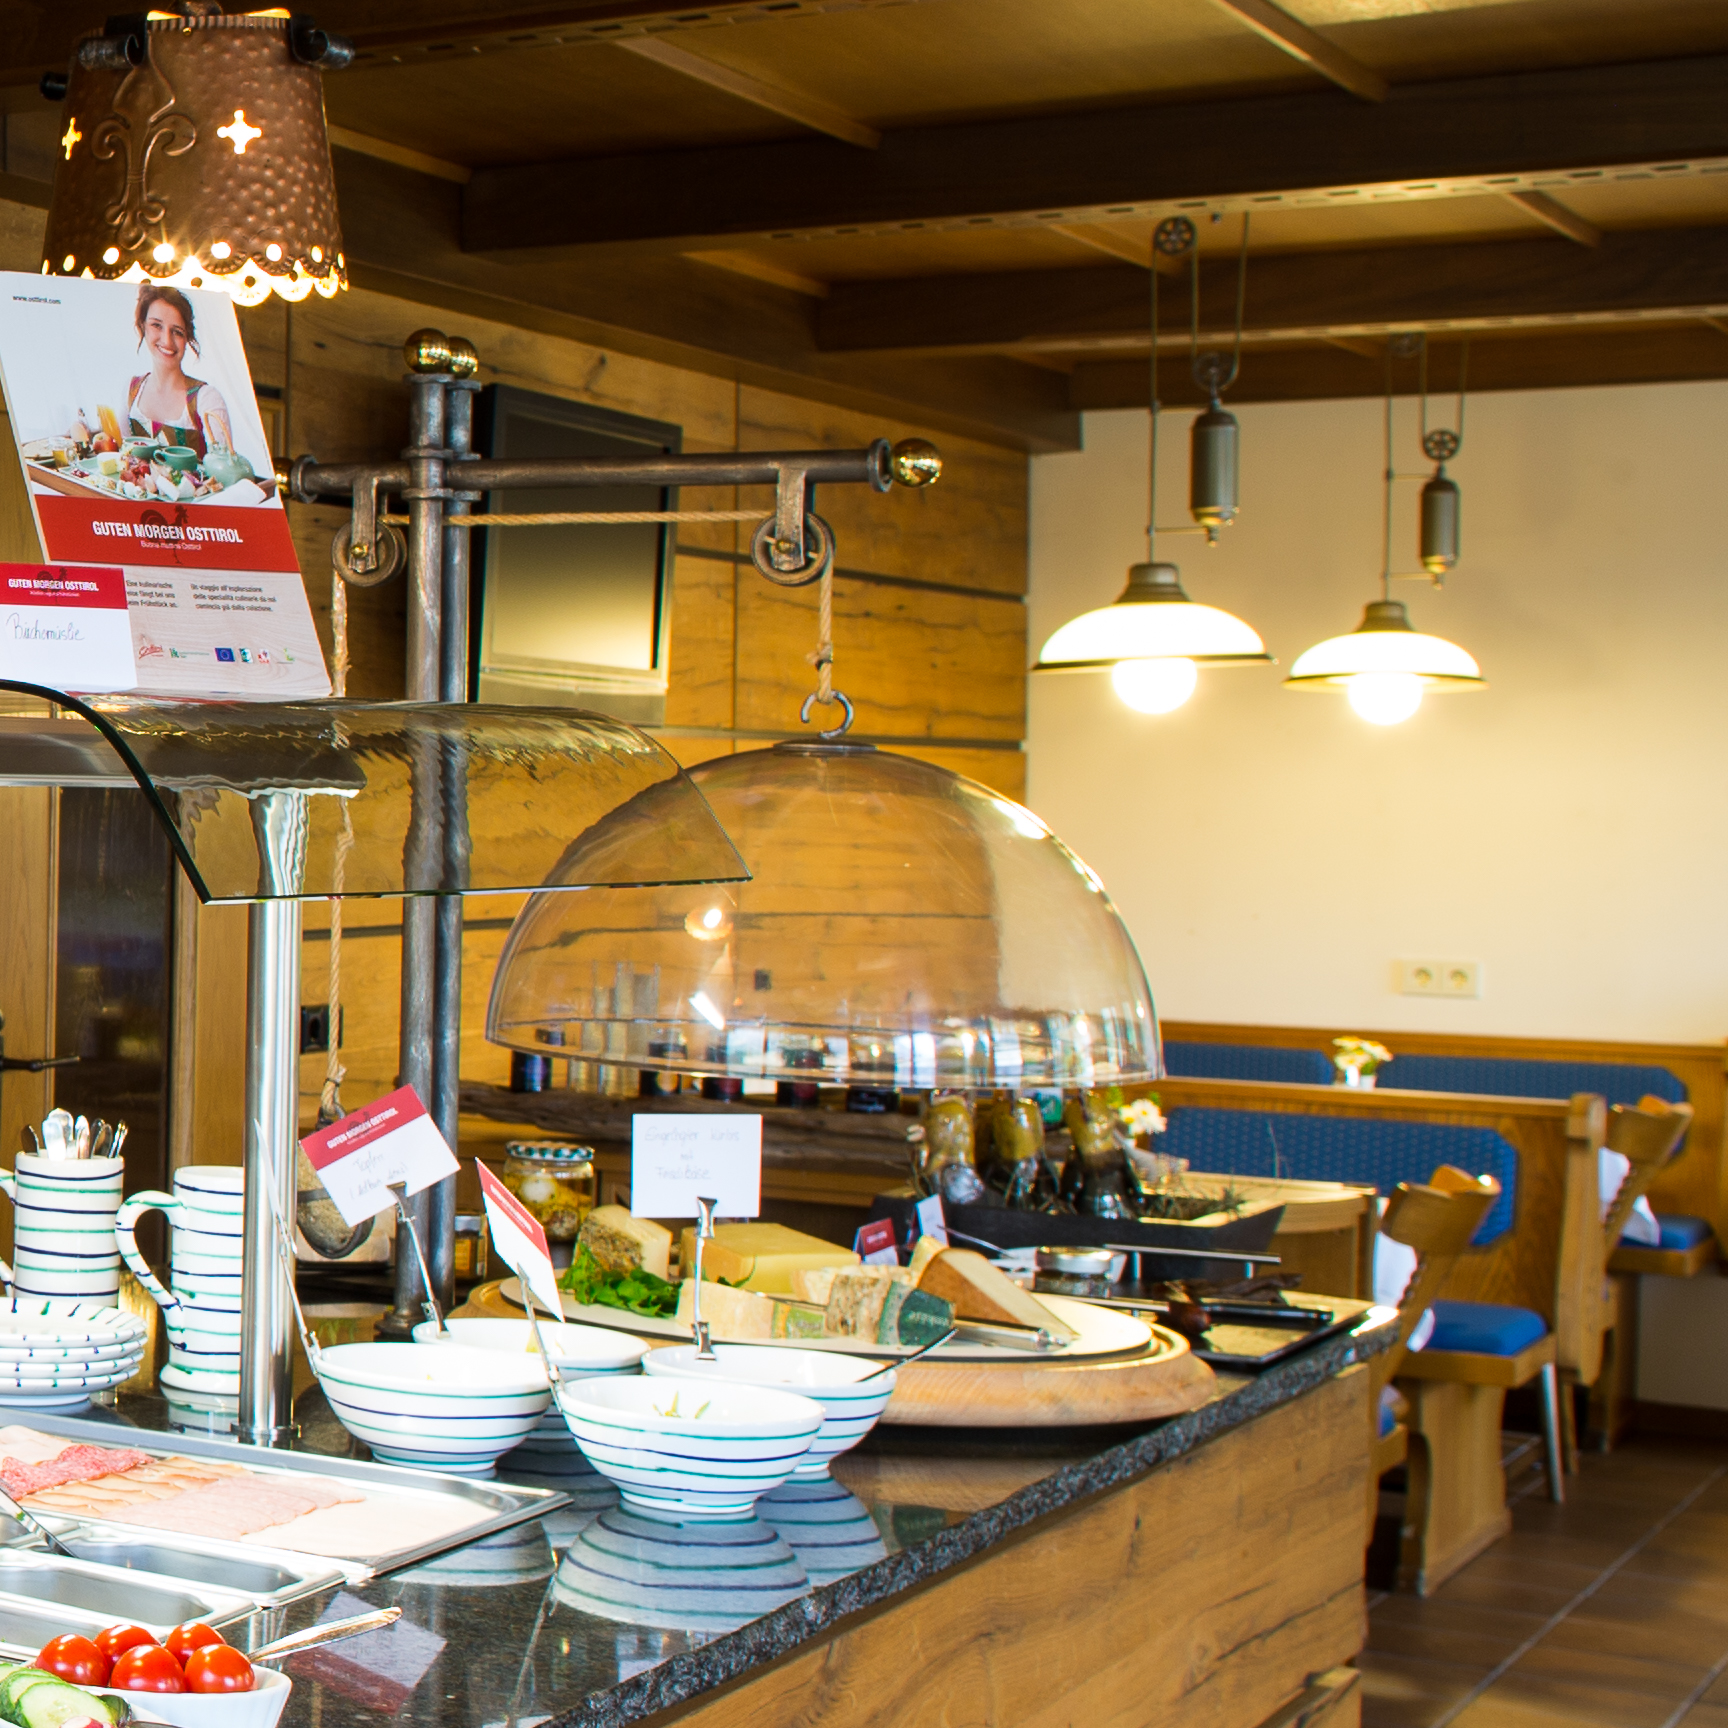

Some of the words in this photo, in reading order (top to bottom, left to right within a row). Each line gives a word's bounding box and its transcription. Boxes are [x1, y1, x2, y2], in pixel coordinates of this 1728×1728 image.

[93, 520, 132, 536] GUTEN
[134, 523, 184, 540] MORGEN
[186, 526, 244, 543] OSTTIROL
[8, 578, 33, 589] GUTEN
[34, 579, 63, 590] MORGEN
[65, 580, 99, 592] OSTTIROL
